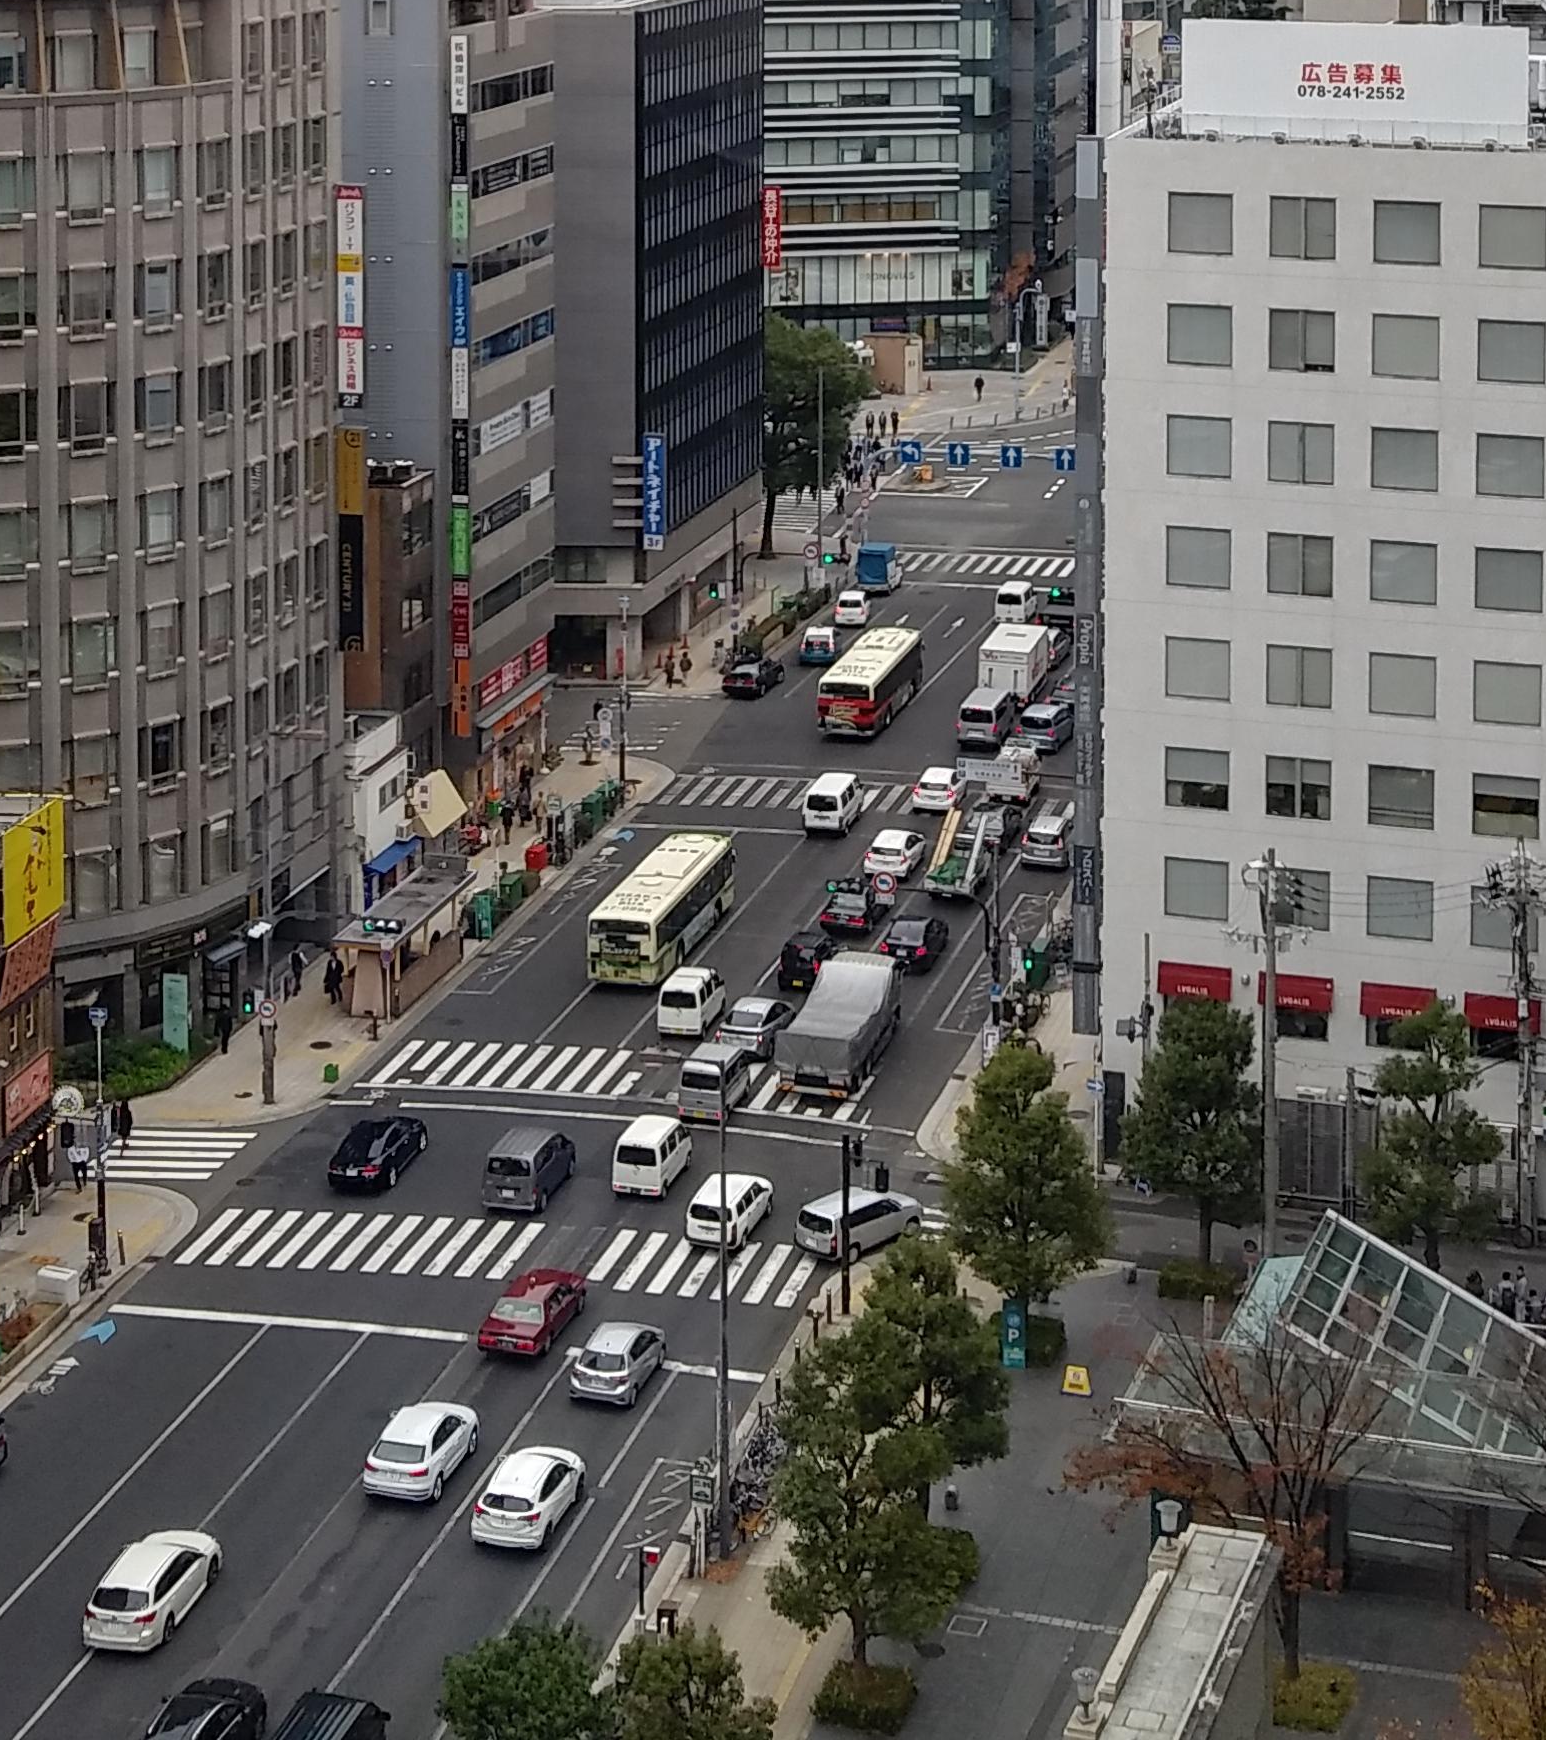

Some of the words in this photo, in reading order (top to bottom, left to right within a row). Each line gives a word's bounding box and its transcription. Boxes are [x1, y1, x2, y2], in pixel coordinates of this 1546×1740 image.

[1300, 62, 1402, 85] 広告募集
[1297, 84, 1405, 101] 078-241-2552
[764, 189, 779, 264] 長谷工の仲介
[342, 394, 359, 407] 2F
[646, 437, 661, 533] アートネイチャー
[646, 537, 661, 547] 3F
[341, 542, 352, 598] CENTURY
[1078, 617, 1094, 666] Propia
[1008, 1328, 1020, 1343] P
